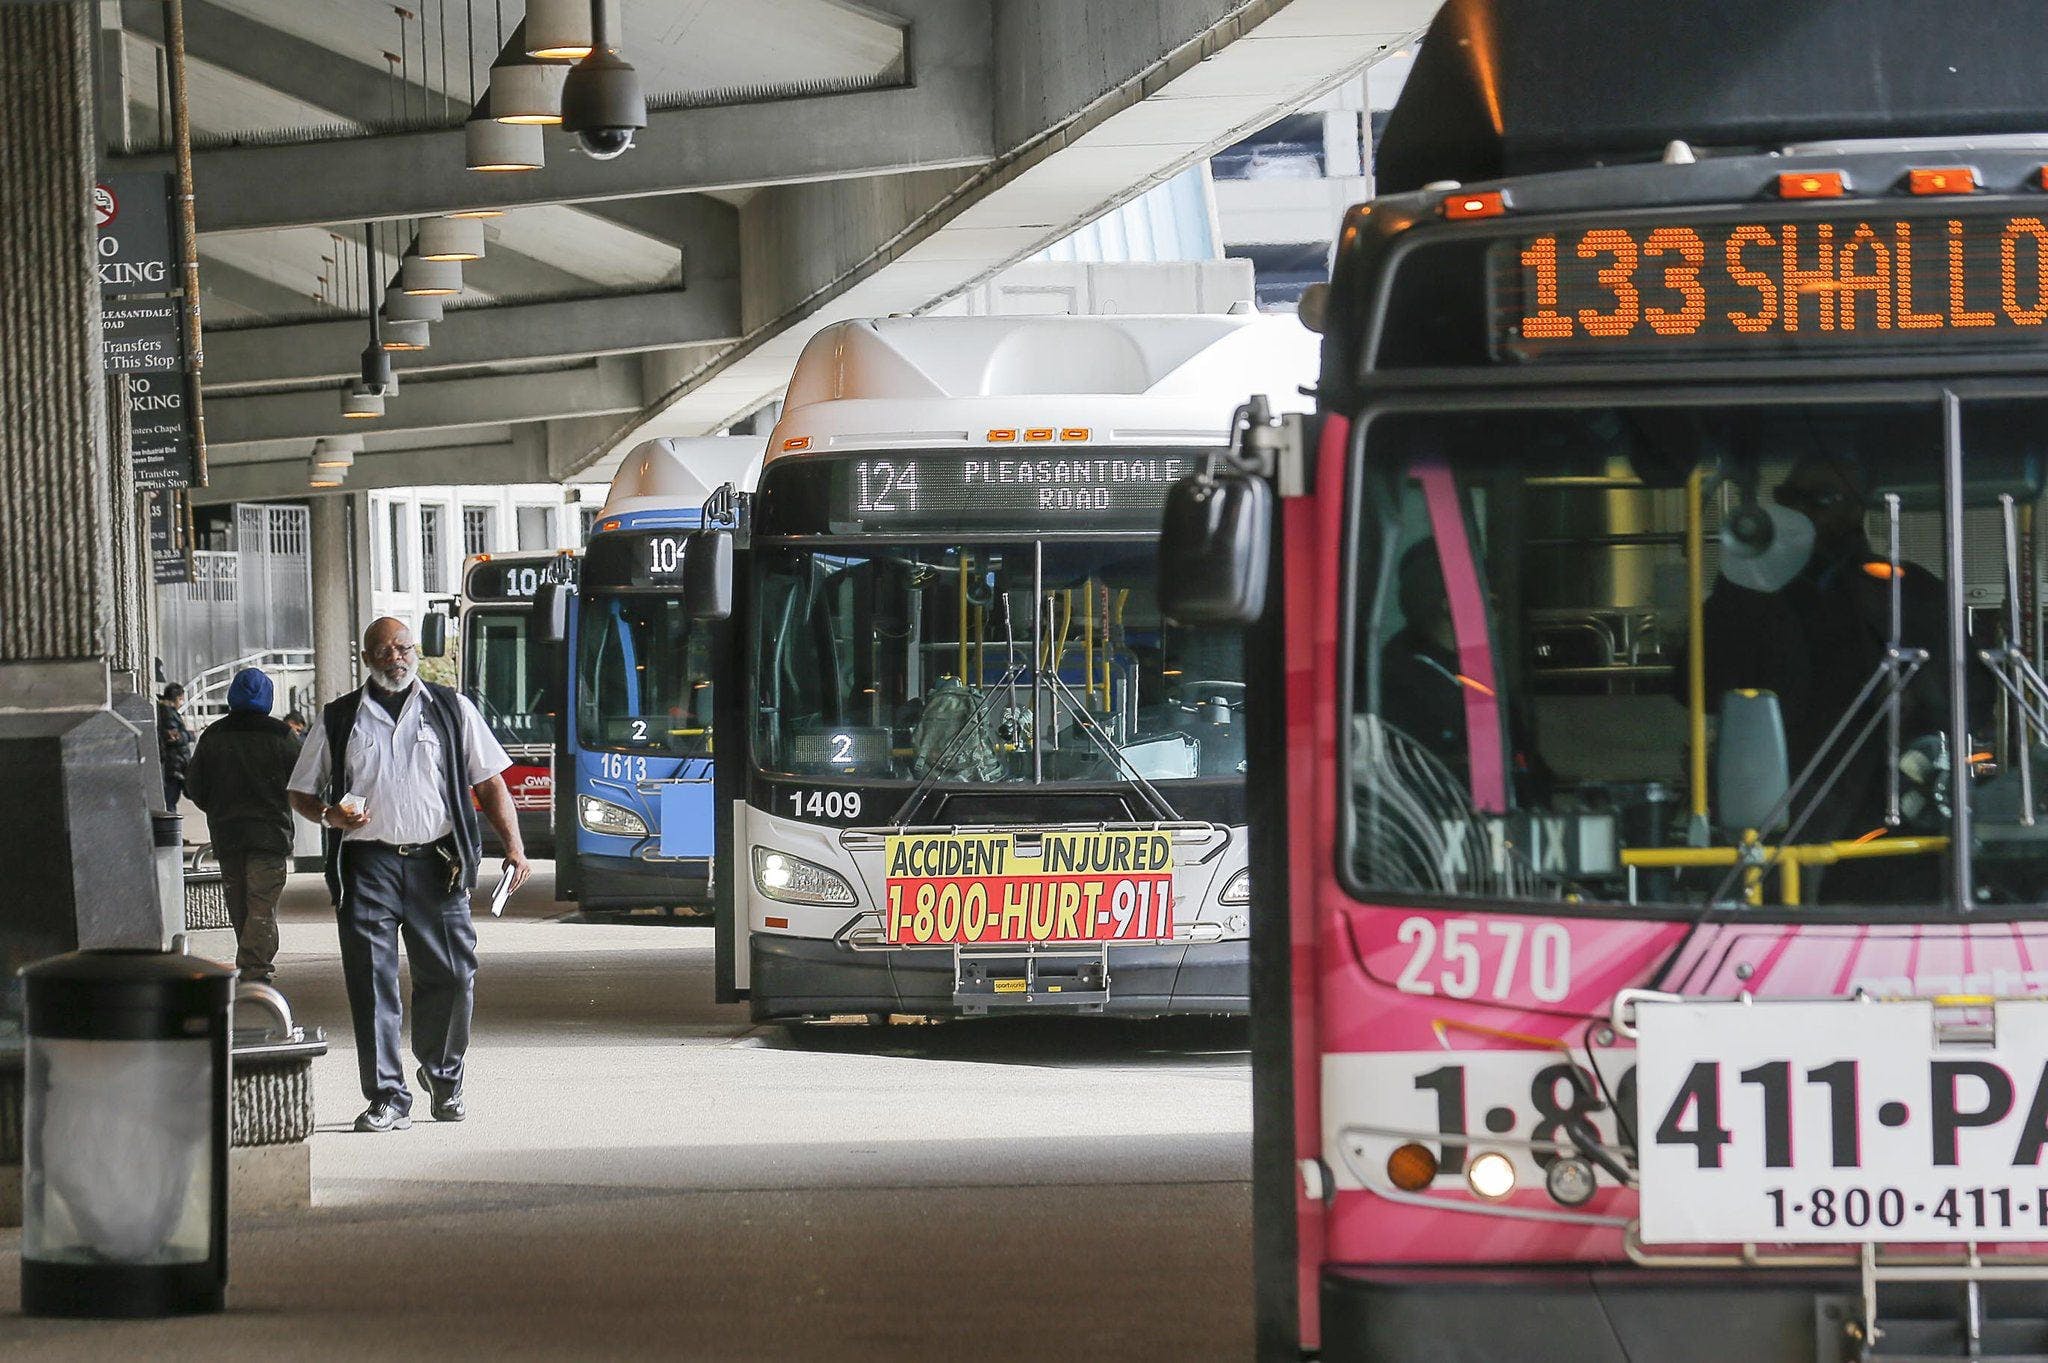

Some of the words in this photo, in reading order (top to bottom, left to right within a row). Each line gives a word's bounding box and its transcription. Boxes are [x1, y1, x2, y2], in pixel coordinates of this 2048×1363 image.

[96, 236, 119, 257] O
[1521, 227, 1705, 338] 133
[1726, 218, 2048, 332] SHALLO
[101, 308, 172, 319] LEASANTDALE
[101, 321, 124, 330] OAD
[102, 339, 161, 353] Transfers
[111, 356, 141, 368] This
[145, 354, 175, 370] Stop
[154, 423, 181, 434] Chapel
[139, 469, 180, 479] Transfers
[964, 459, 1182, 483] PLEASANTDALE
[167, 478, 188, 489] Stop
[856, 461, 919, 512] 124
[1038, 487, 1110, 511] ROAD
[631, 719, 647, 740] 2
[831, 735, 852, 763] 2
[601, 752, 647, 782] 1613
[789, 791, 862, 819] 1409
[890, 838, 1009, 878] ACCIDENT
[1042, 834, 1171, 874] INJURED
[888, 879, 1171, 943] 1-800-HURT-911
[1395, 916, 1573, 1004] 2570
